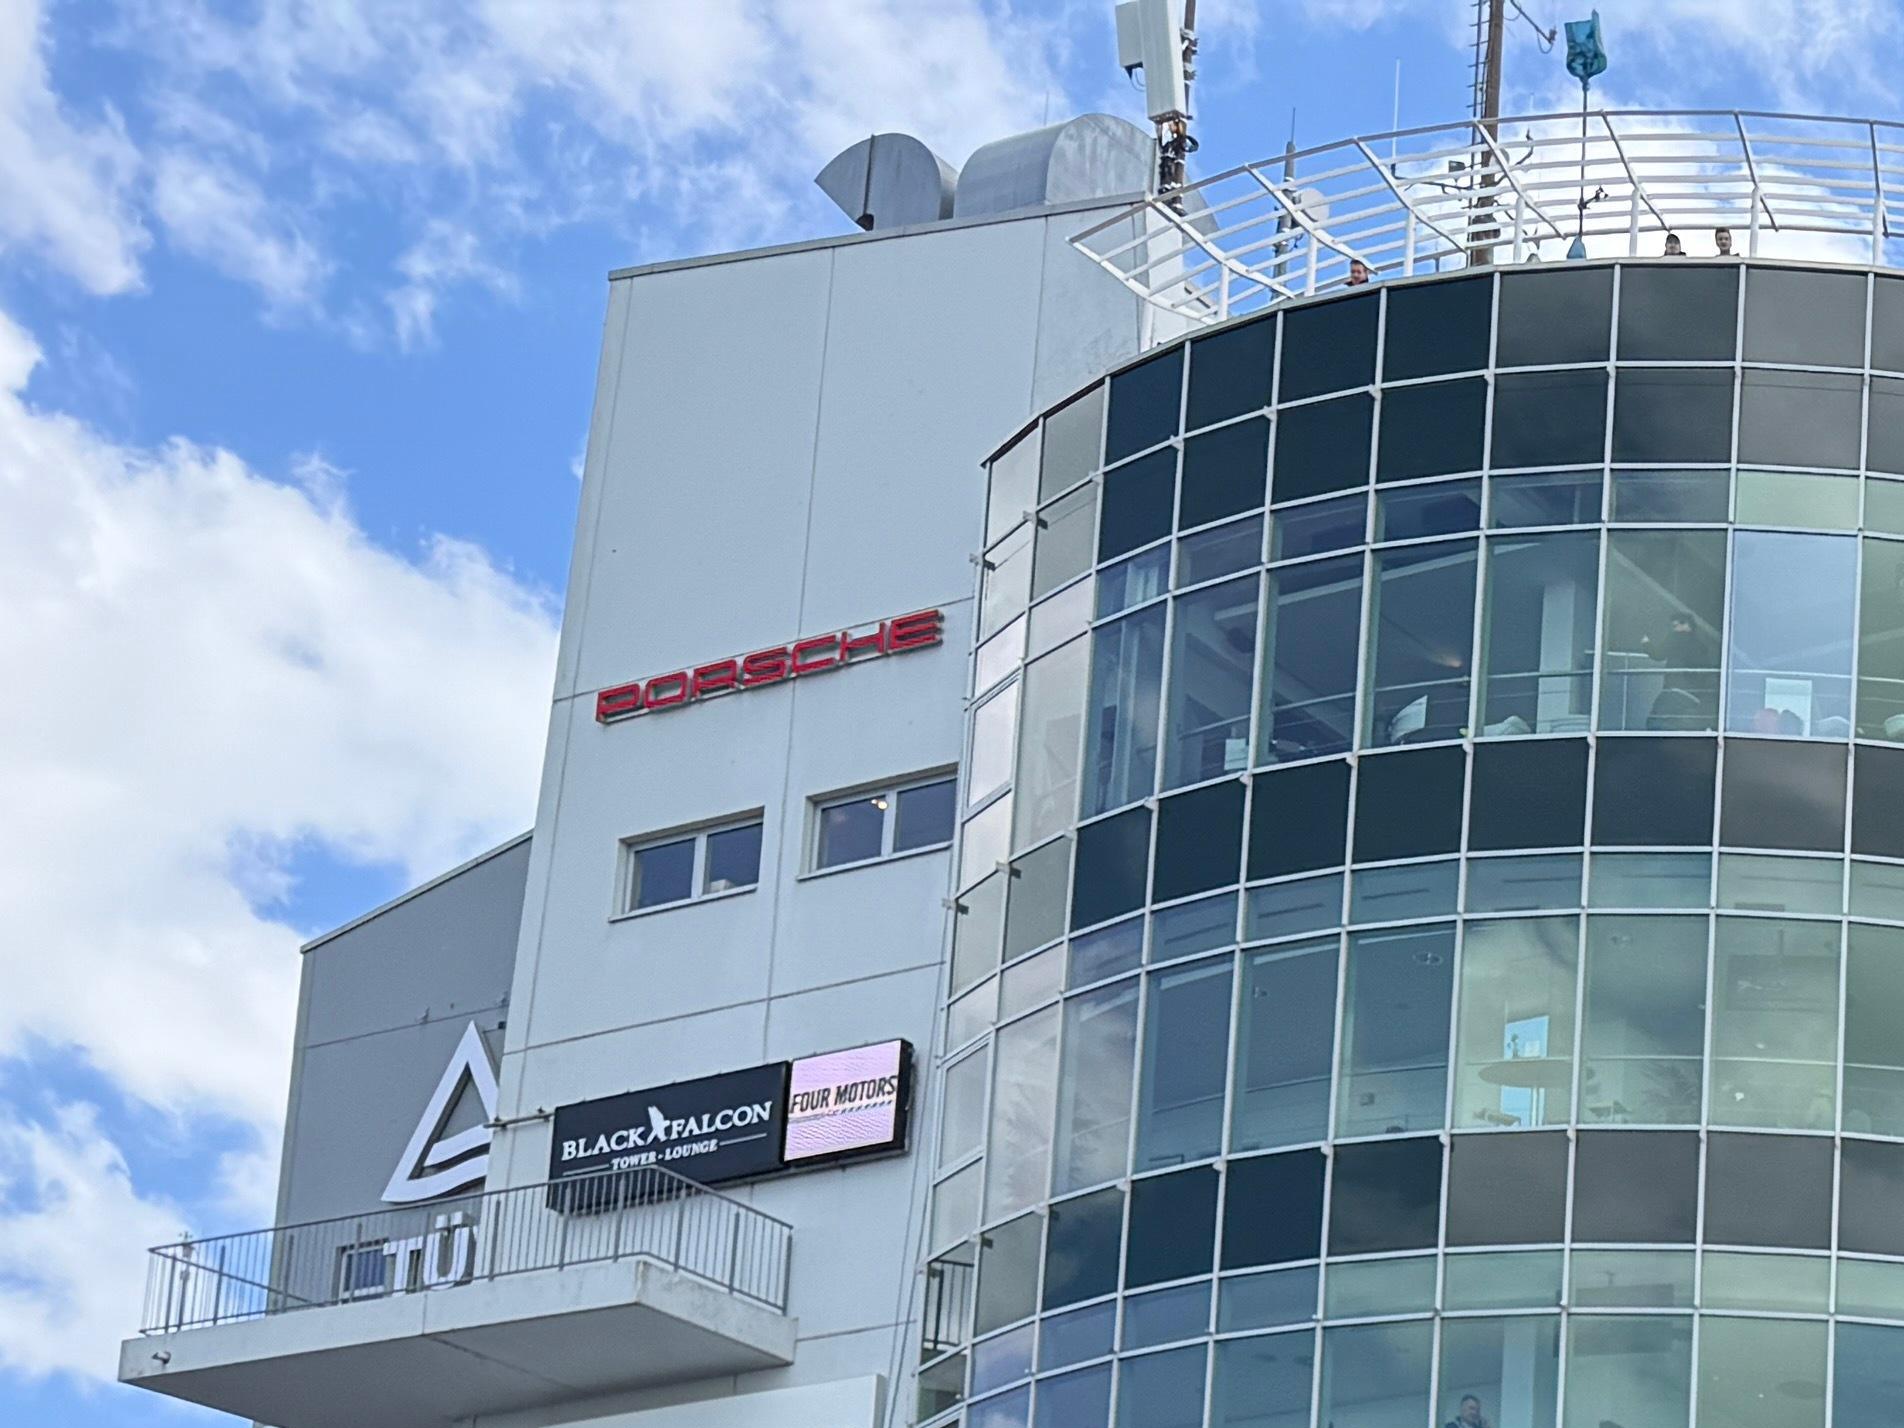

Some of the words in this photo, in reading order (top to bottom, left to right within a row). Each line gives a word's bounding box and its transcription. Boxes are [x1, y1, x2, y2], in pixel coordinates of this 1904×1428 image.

[595, 608, 946, 725] PORSCHE
[561, 1126, 645, 1162] BLACK
[668, 1100, 773, 1140] FALCON
[791, 1088, 830, 1114] FOUR
[835, 1075, 899, 1104] MOTORS
[383, 1211, 481, 1297] TÜ
